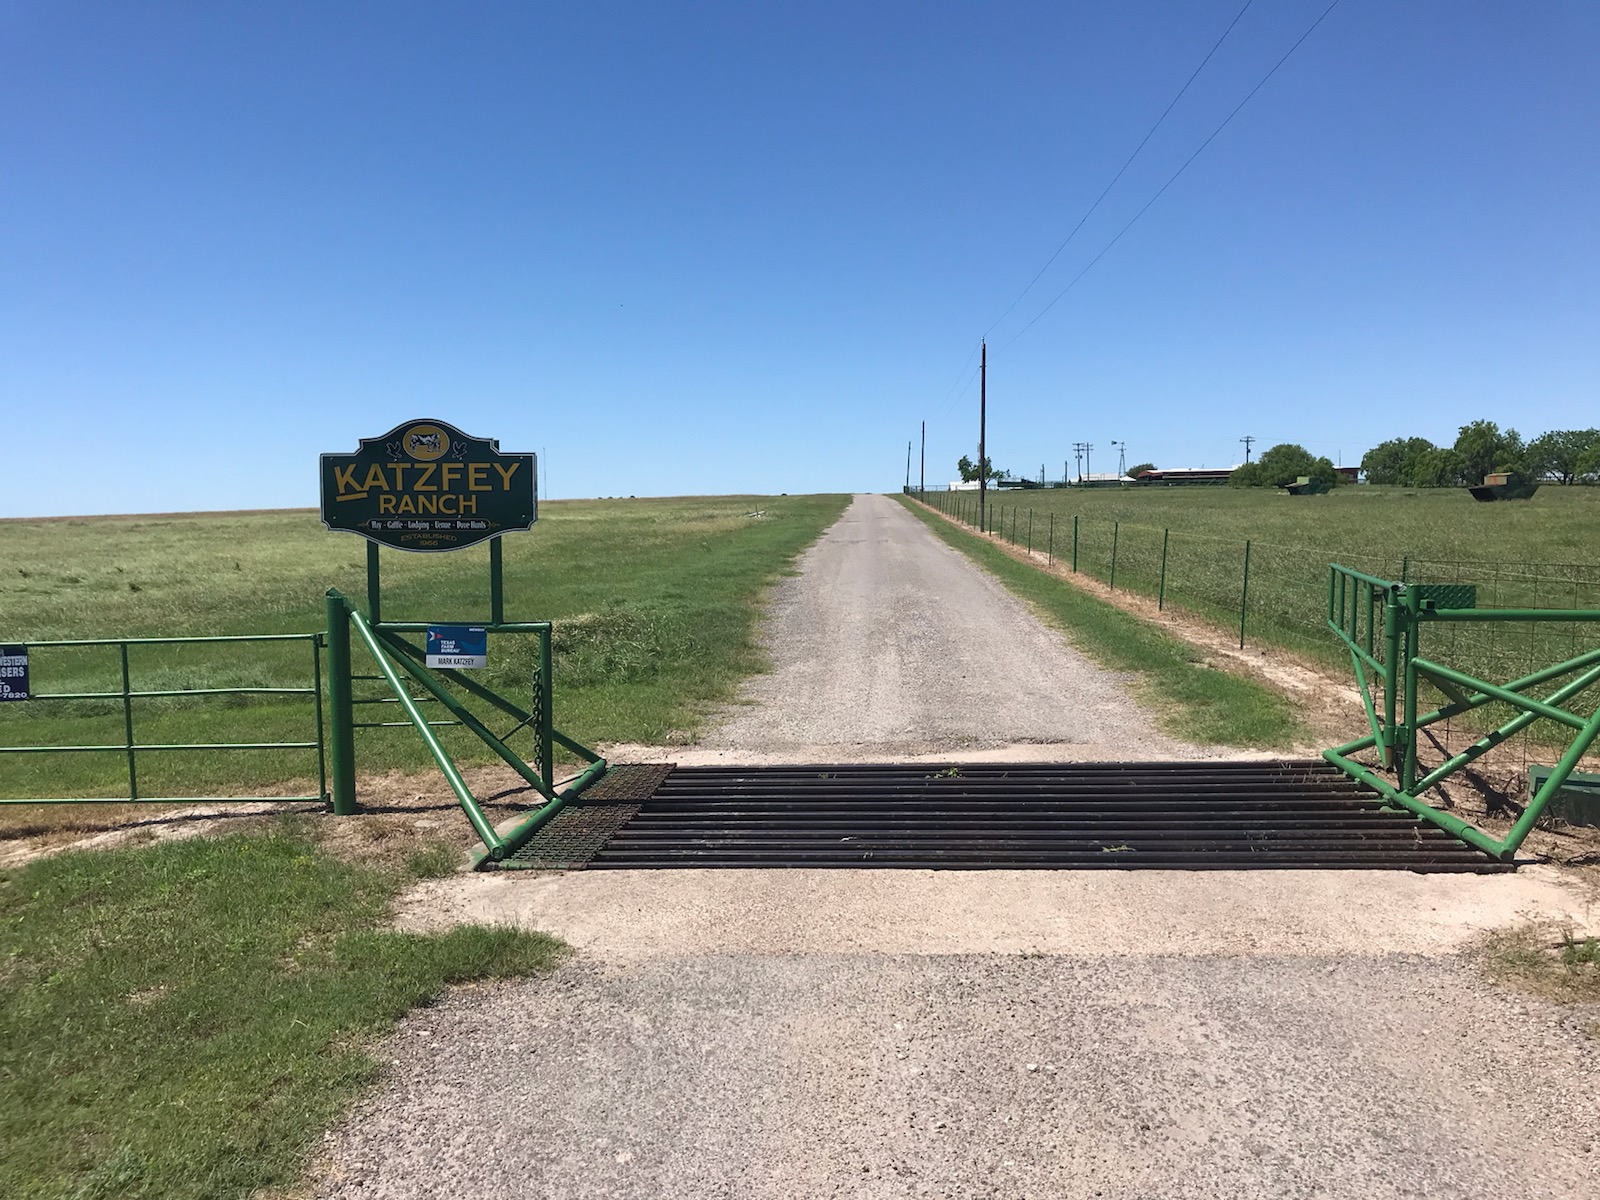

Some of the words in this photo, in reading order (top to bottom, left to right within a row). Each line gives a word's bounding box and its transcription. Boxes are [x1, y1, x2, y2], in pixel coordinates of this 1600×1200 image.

[334, 462, 520, 497] KATZFEY
[379, 494, 477, 514] RANCH
[387, 520, 404, 529] Cattle
[408, 520, 430, 530] Lodging
[456, 520, 470, 529] Dove
[400, 533, 458, 542] ESTABLISHED
[0, 666, 24, 677] SERS
